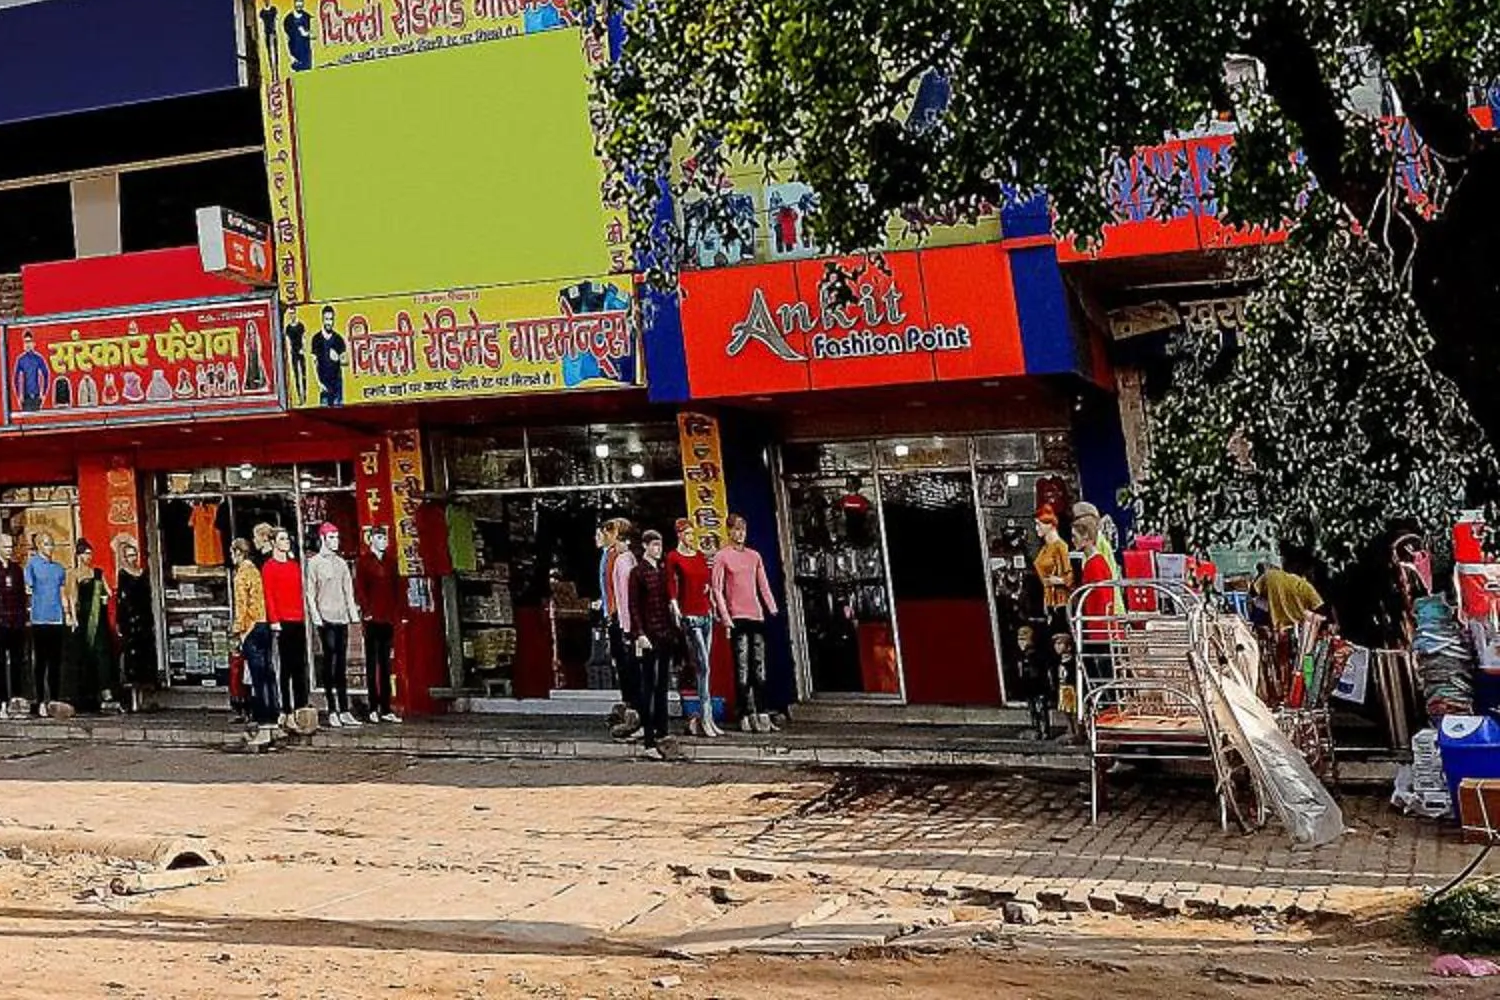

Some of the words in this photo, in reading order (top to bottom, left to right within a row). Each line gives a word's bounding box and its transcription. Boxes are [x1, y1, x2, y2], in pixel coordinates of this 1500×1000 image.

[48, 329, 150, 373] संस्कार
[154, 318, 240, 363] फैशन
[348, 311, 416, 377] दिल्ली
[422, 307, 503, 373] रेडिमेड
[507, 296, 631, 380] गारमेन्ट्स
[726, 283, 907, 361] Ankit
[905, 324, 972, 353] Point
[408, 381, 423, 394] पर
[450, 377, 478, 391] दिल्ली
[495, 374, 509, 386] पर
